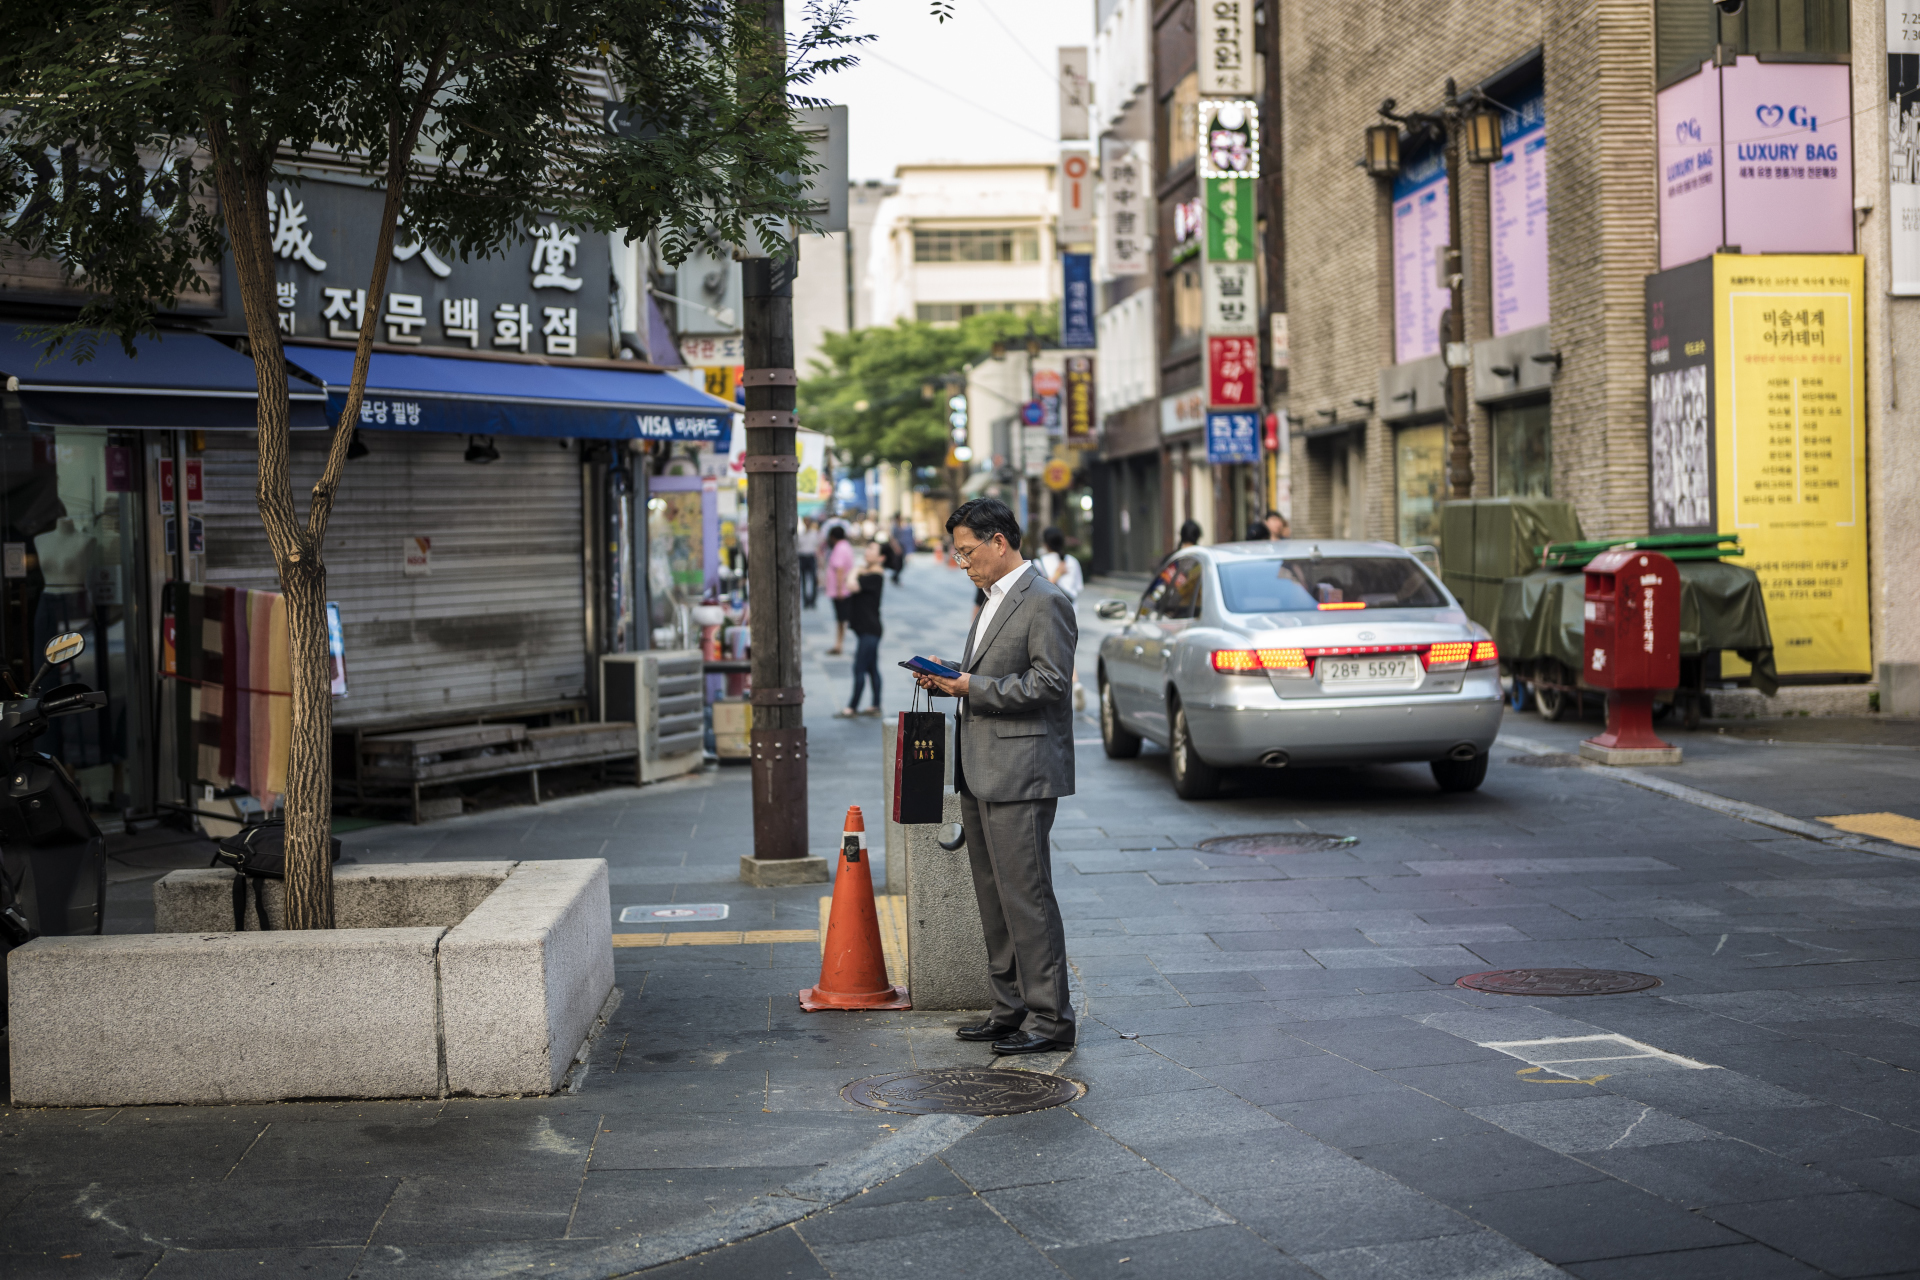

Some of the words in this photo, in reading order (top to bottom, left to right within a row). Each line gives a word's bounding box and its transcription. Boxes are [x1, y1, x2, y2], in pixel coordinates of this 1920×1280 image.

[1738, 143, 1799, 161] LUXURY
[1806, 143, 1838, 161] BAG
[322, 286, 578, 357] 전문백화점
[1763, 309, 1825, 328] 미술세계
[1763, 329, 1825, 348] 아카데미
[360, 400, 389, 425] 문당
[391, 401, 422, 426] 필방
[637, 414, 673, 436] VISA
[674, 417, 721, 438] 비자카드
[1331, 662, 1360, 679] 28무
[1368, 661, 1407, 676] 5597
